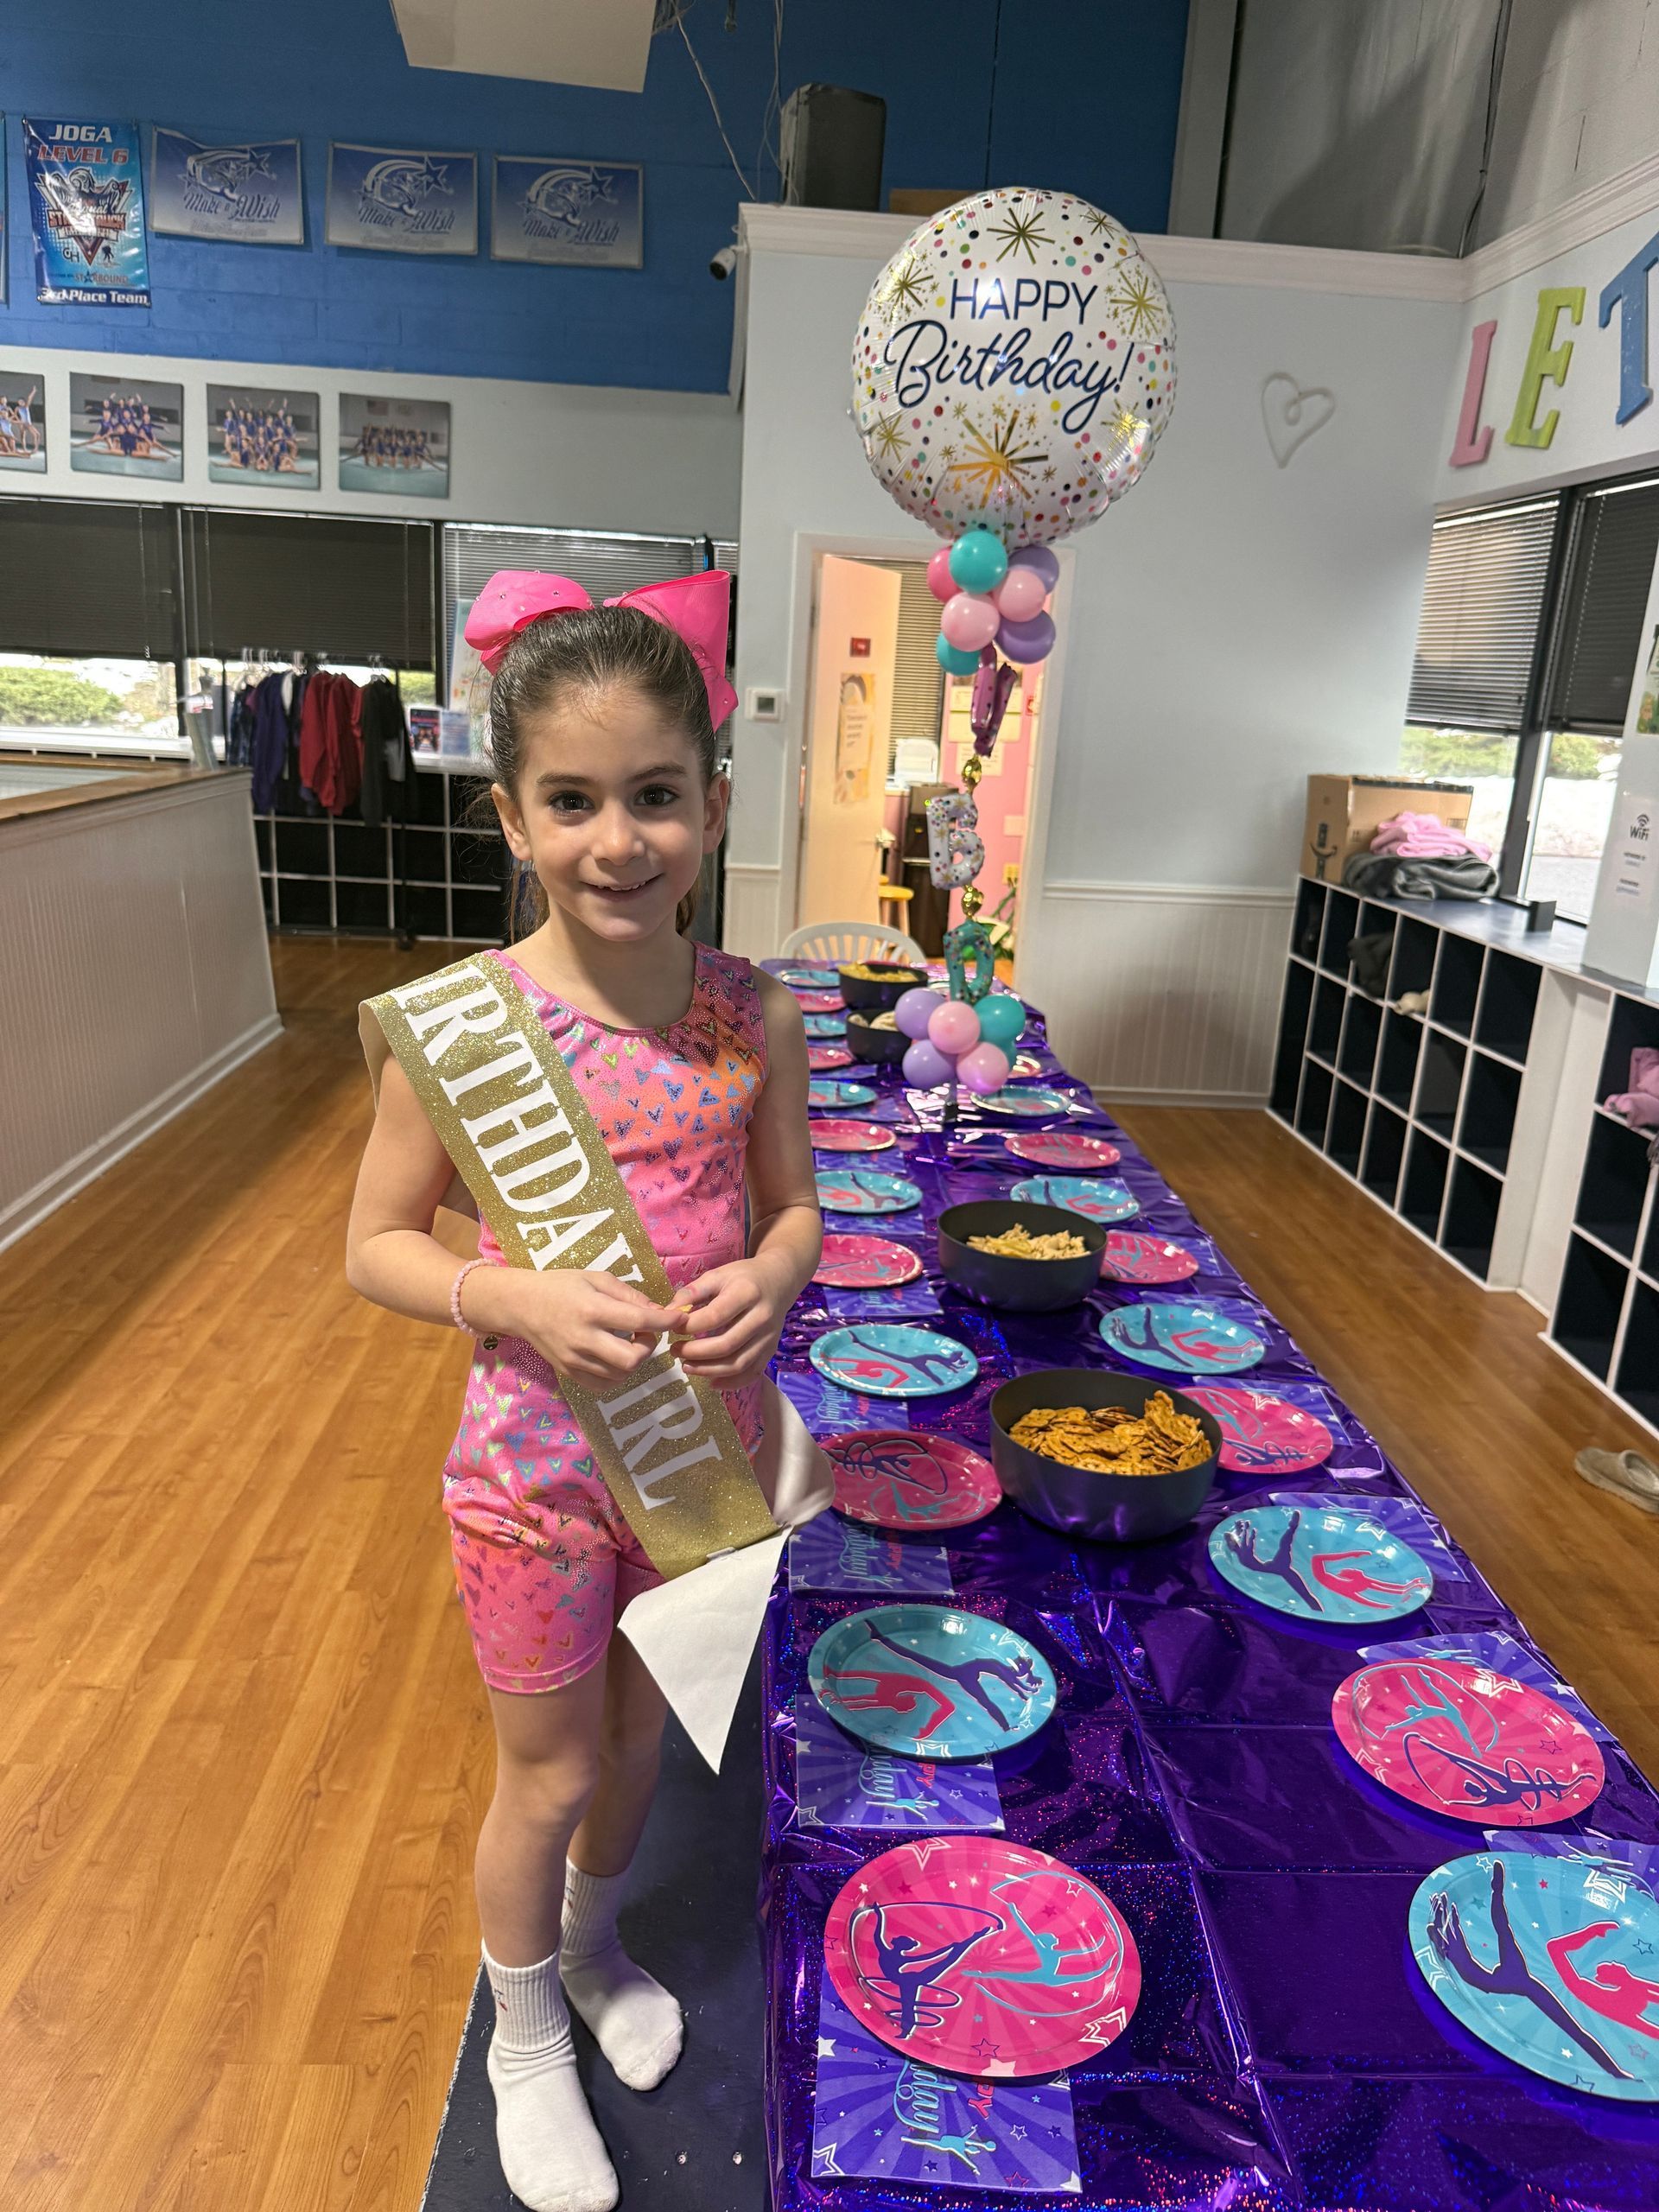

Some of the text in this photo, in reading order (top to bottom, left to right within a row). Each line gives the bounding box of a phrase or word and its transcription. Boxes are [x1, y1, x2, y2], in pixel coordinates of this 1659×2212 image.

[48, 124, 112, 143] JOGA
[37, 144, 130, 166] LEVEL 6
[230, 193, 282, 219] Wish
[69, 289, 107, 302] Place
[109, 290, 148, 304] Team
[949, 277, 1098, 325] HAPPY
[1449, 230, 1659, 469] LET
[883, 319, 1135, 435] Birthday!
[1630, 825, 1649, 842] WiFi
[595, 1331, 724, 1511] IRL
